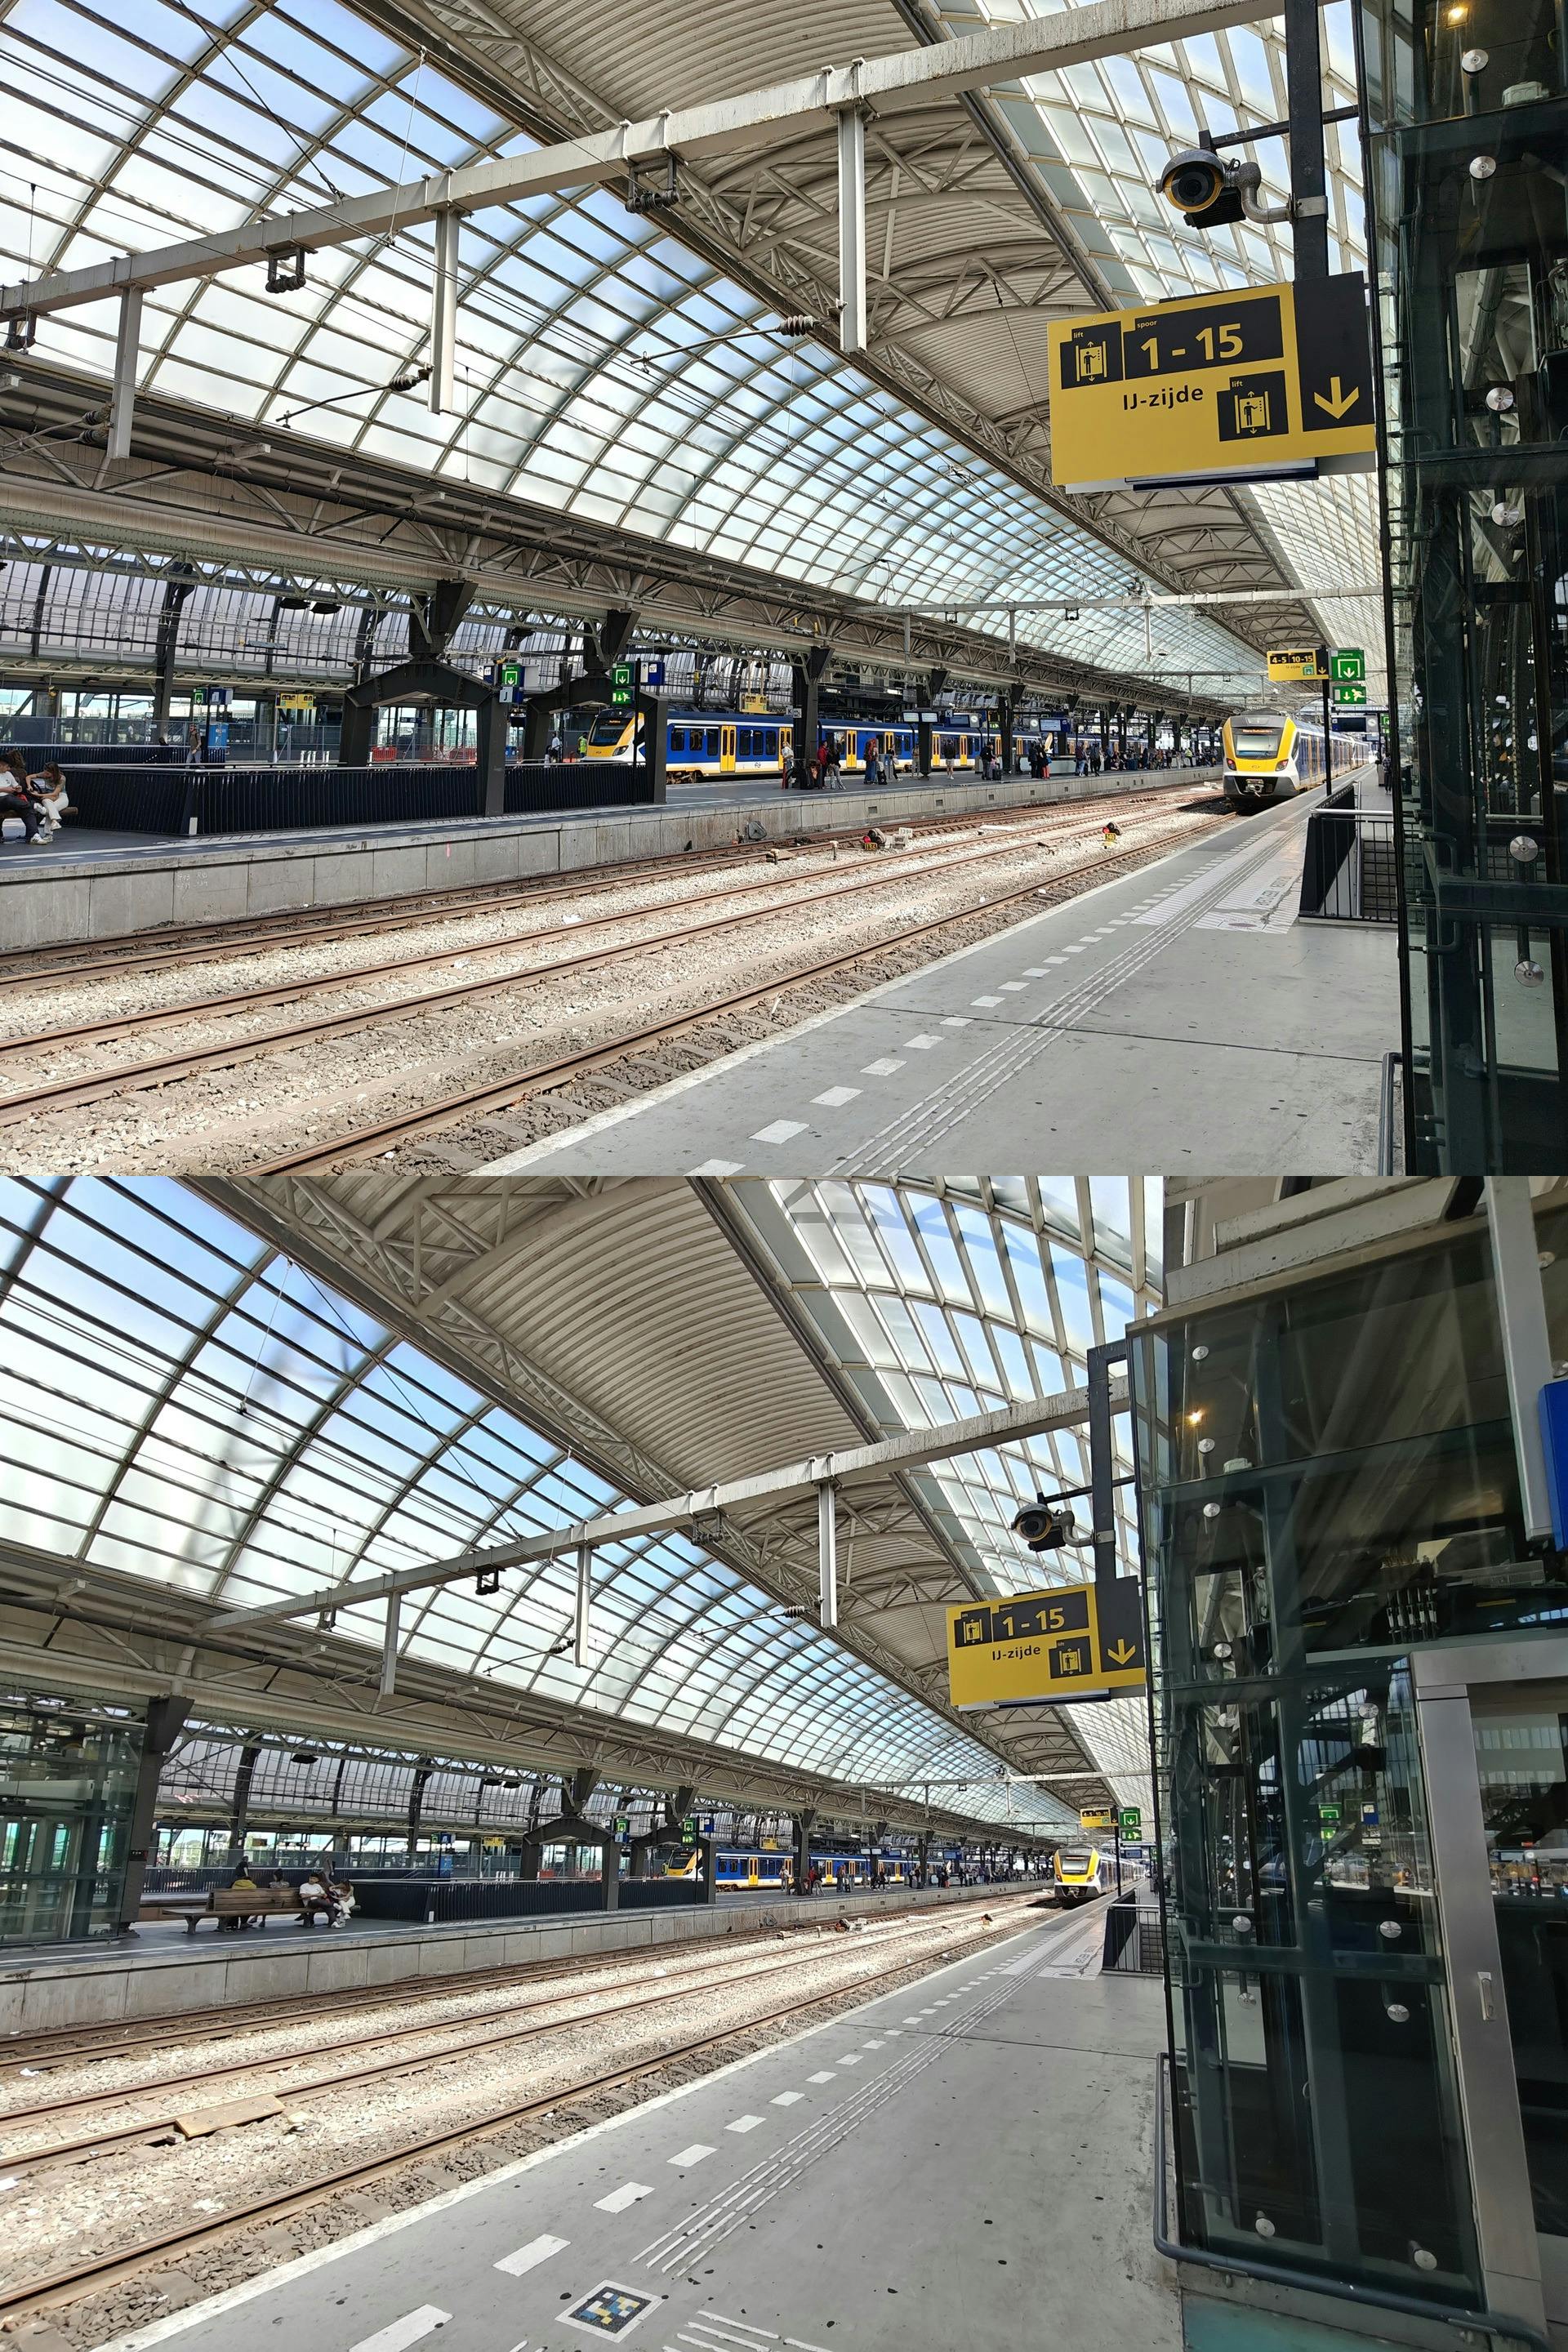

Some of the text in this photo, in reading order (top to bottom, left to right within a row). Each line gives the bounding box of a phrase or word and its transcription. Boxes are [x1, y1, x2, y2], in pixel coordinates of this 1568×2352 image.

[1136, 318, 1158, 329] spoor
[1073, 331, 1084, 339] lift
[1231, 380, 1243, 388] lift
[1122, 385, 1205, 411] IJ-zijde
[992, 1646, 1040, 1661] IJ-zijde
